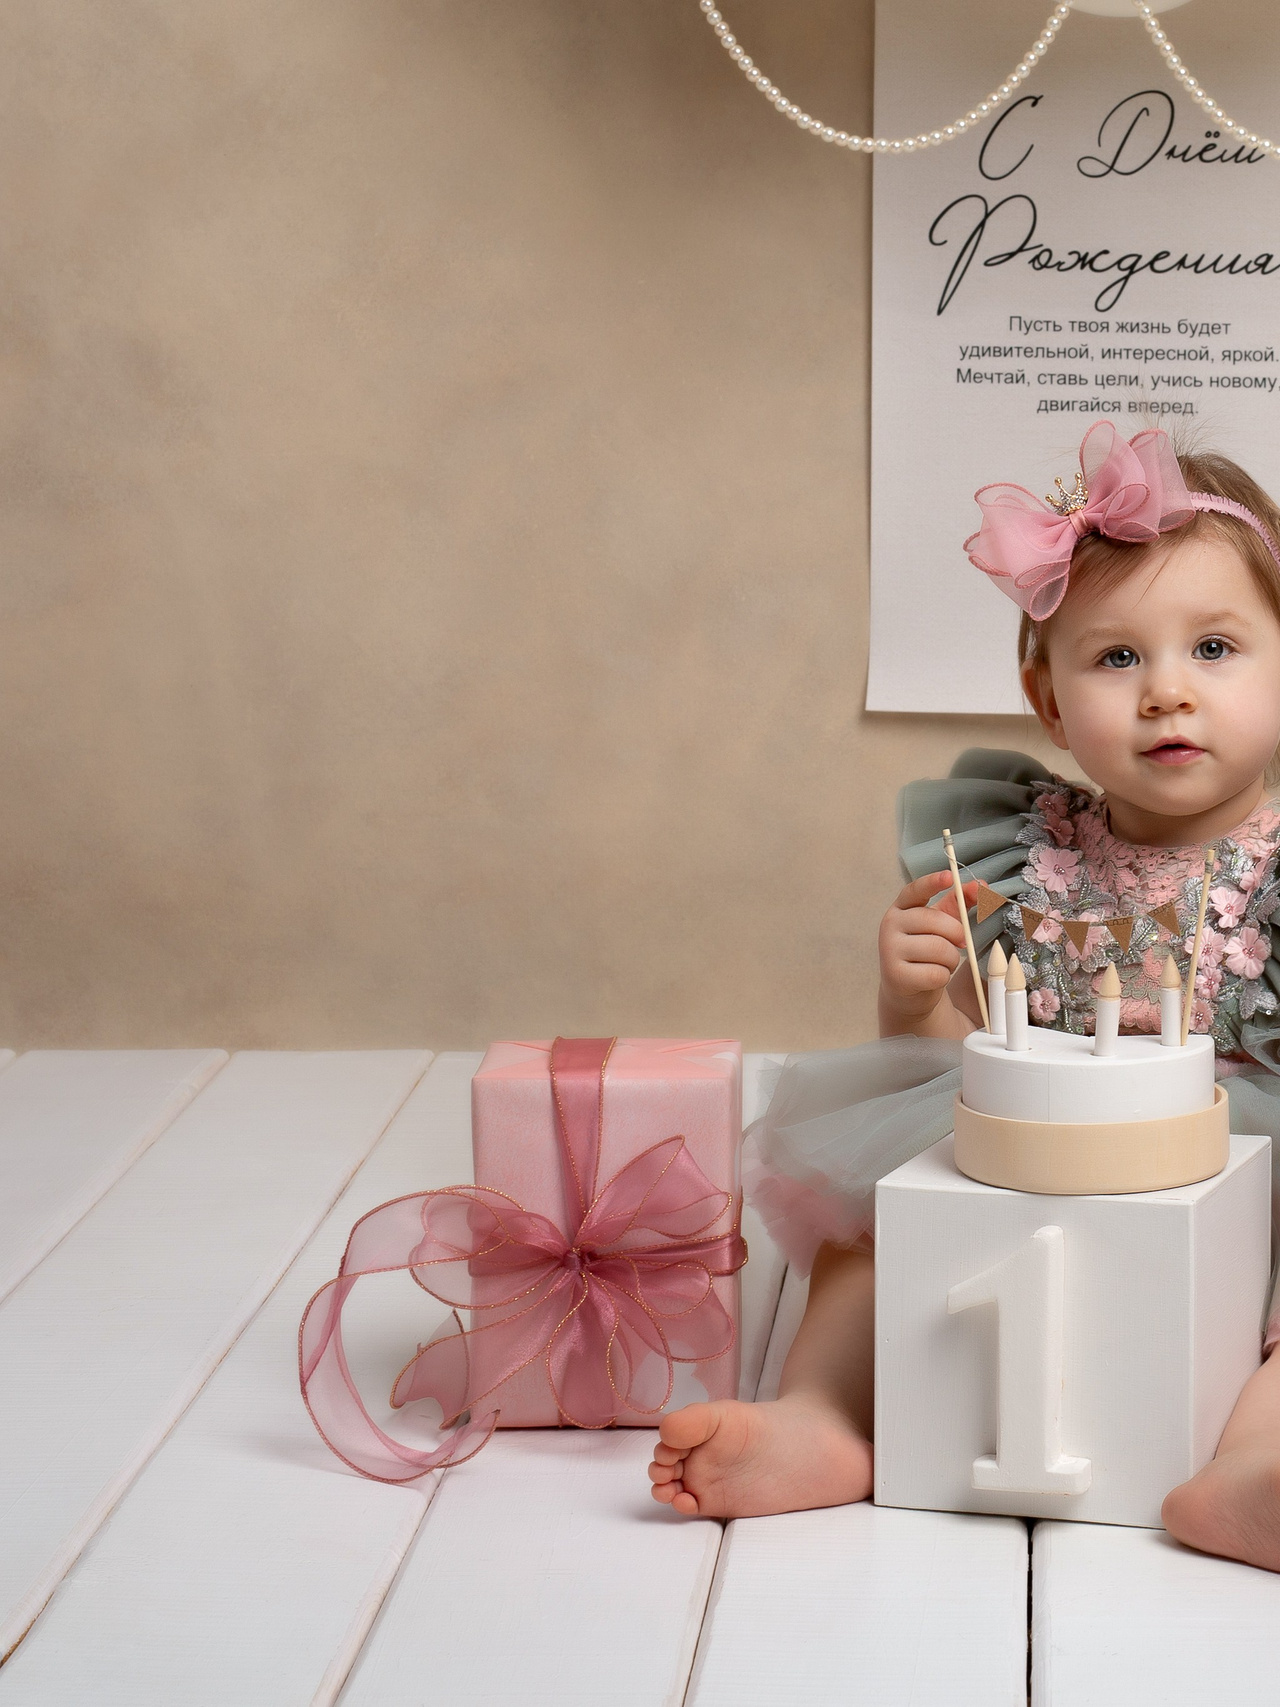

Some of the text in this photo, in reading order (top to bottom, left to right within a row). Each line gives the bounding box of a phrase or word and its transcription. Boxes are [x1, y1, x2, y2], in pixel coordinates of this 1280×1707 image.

[979, 89, 1266, 181] С Днём
[1008, 315, 1231, 337] Пусть твоя жизнь будет
[958, 343, 1280, 365] удивительной, интересной, яркой.
[956, 368, 1031, 388] Мечтай,
[1037, 372, 1089, 386] ставь
[1094, 373, 1144, 389] цели,
[1150, 374, 1203, 391] учись
[1036, 396, 1199, 415] двигайся вперед.
[947, 1225, 1092, 1496] 1
